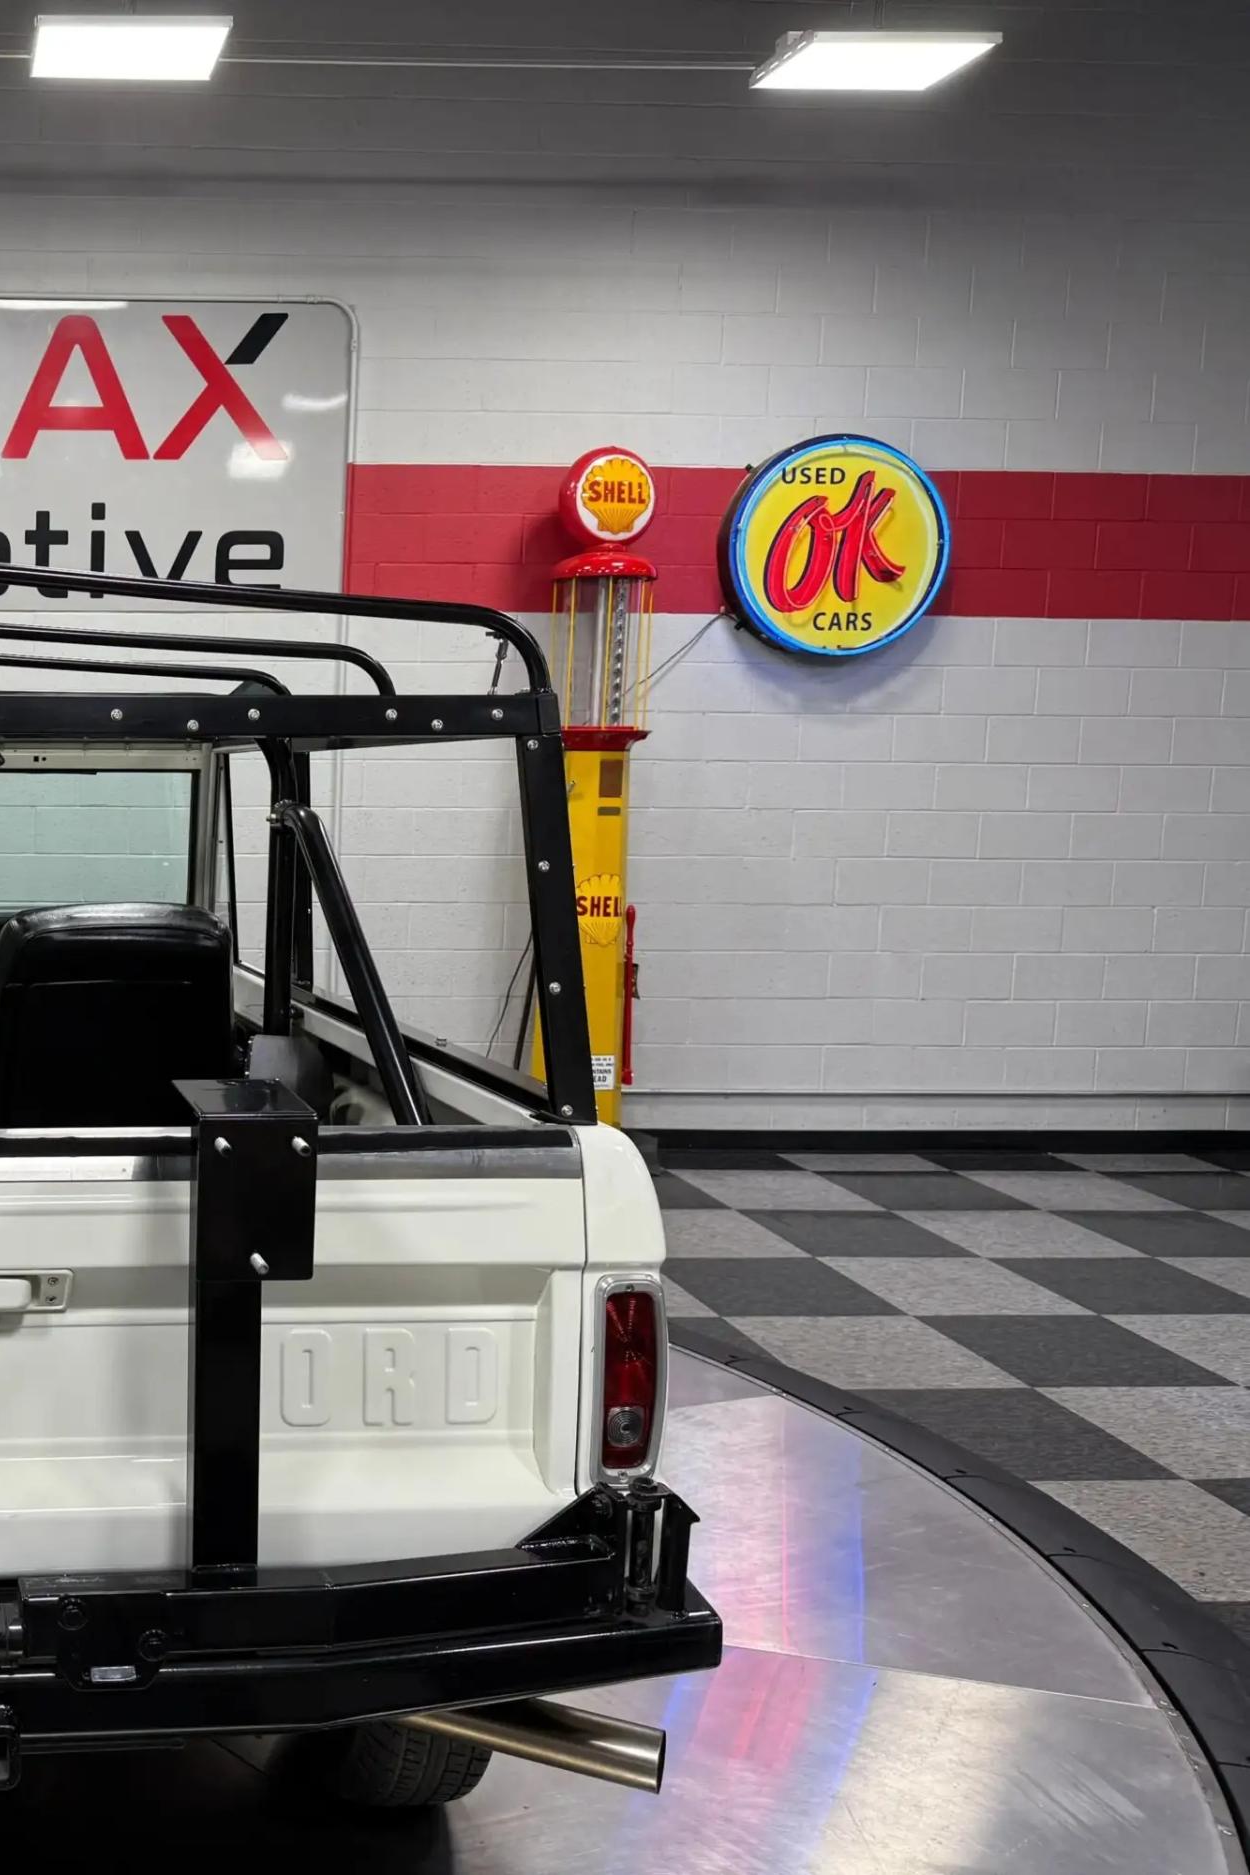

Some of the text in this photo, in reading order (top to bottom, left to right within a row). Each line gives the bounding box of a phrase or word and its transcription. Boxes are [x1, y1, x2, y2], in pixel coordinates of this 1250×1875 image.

[782, 467, 846, 485] USED
[587, 480, 646, 505] SHELL
[763, 470, 906, 613] OK
[812, 612, 872, 631] CARS
[280, 1327, 498, 1427] ORD
